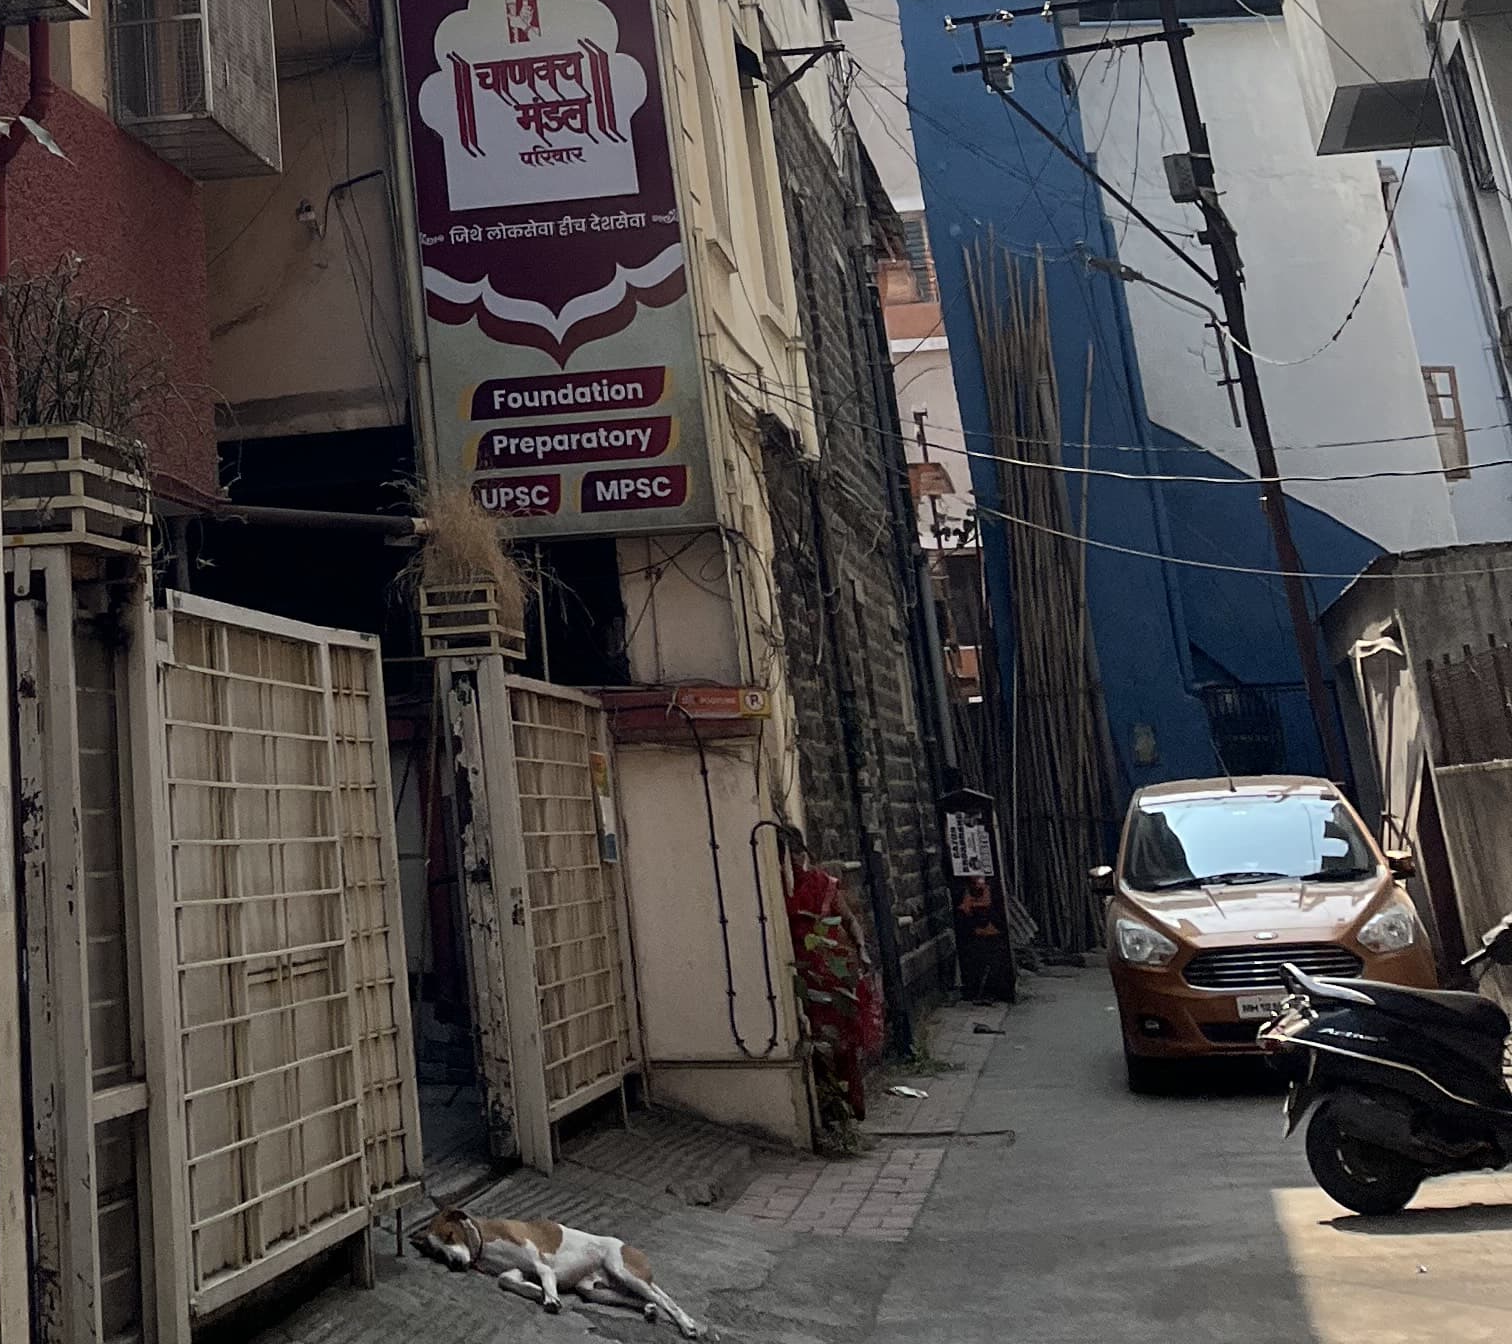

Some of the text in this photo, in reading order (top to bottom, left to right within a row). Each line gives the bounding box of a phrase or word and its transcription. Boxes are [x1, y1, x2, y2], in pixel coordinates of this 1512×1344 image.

[519, 144, 587, 167] परिवार
[449, 210, 646, 245] जिथे लोकसेवा हीच देशसेवा
[493, 379, 644, 411] Foundation
[492, 427, 652, 460] Preparatory
[480, 485, 550, 509] UPSC
[595, 476, 672, 502] MPSC
